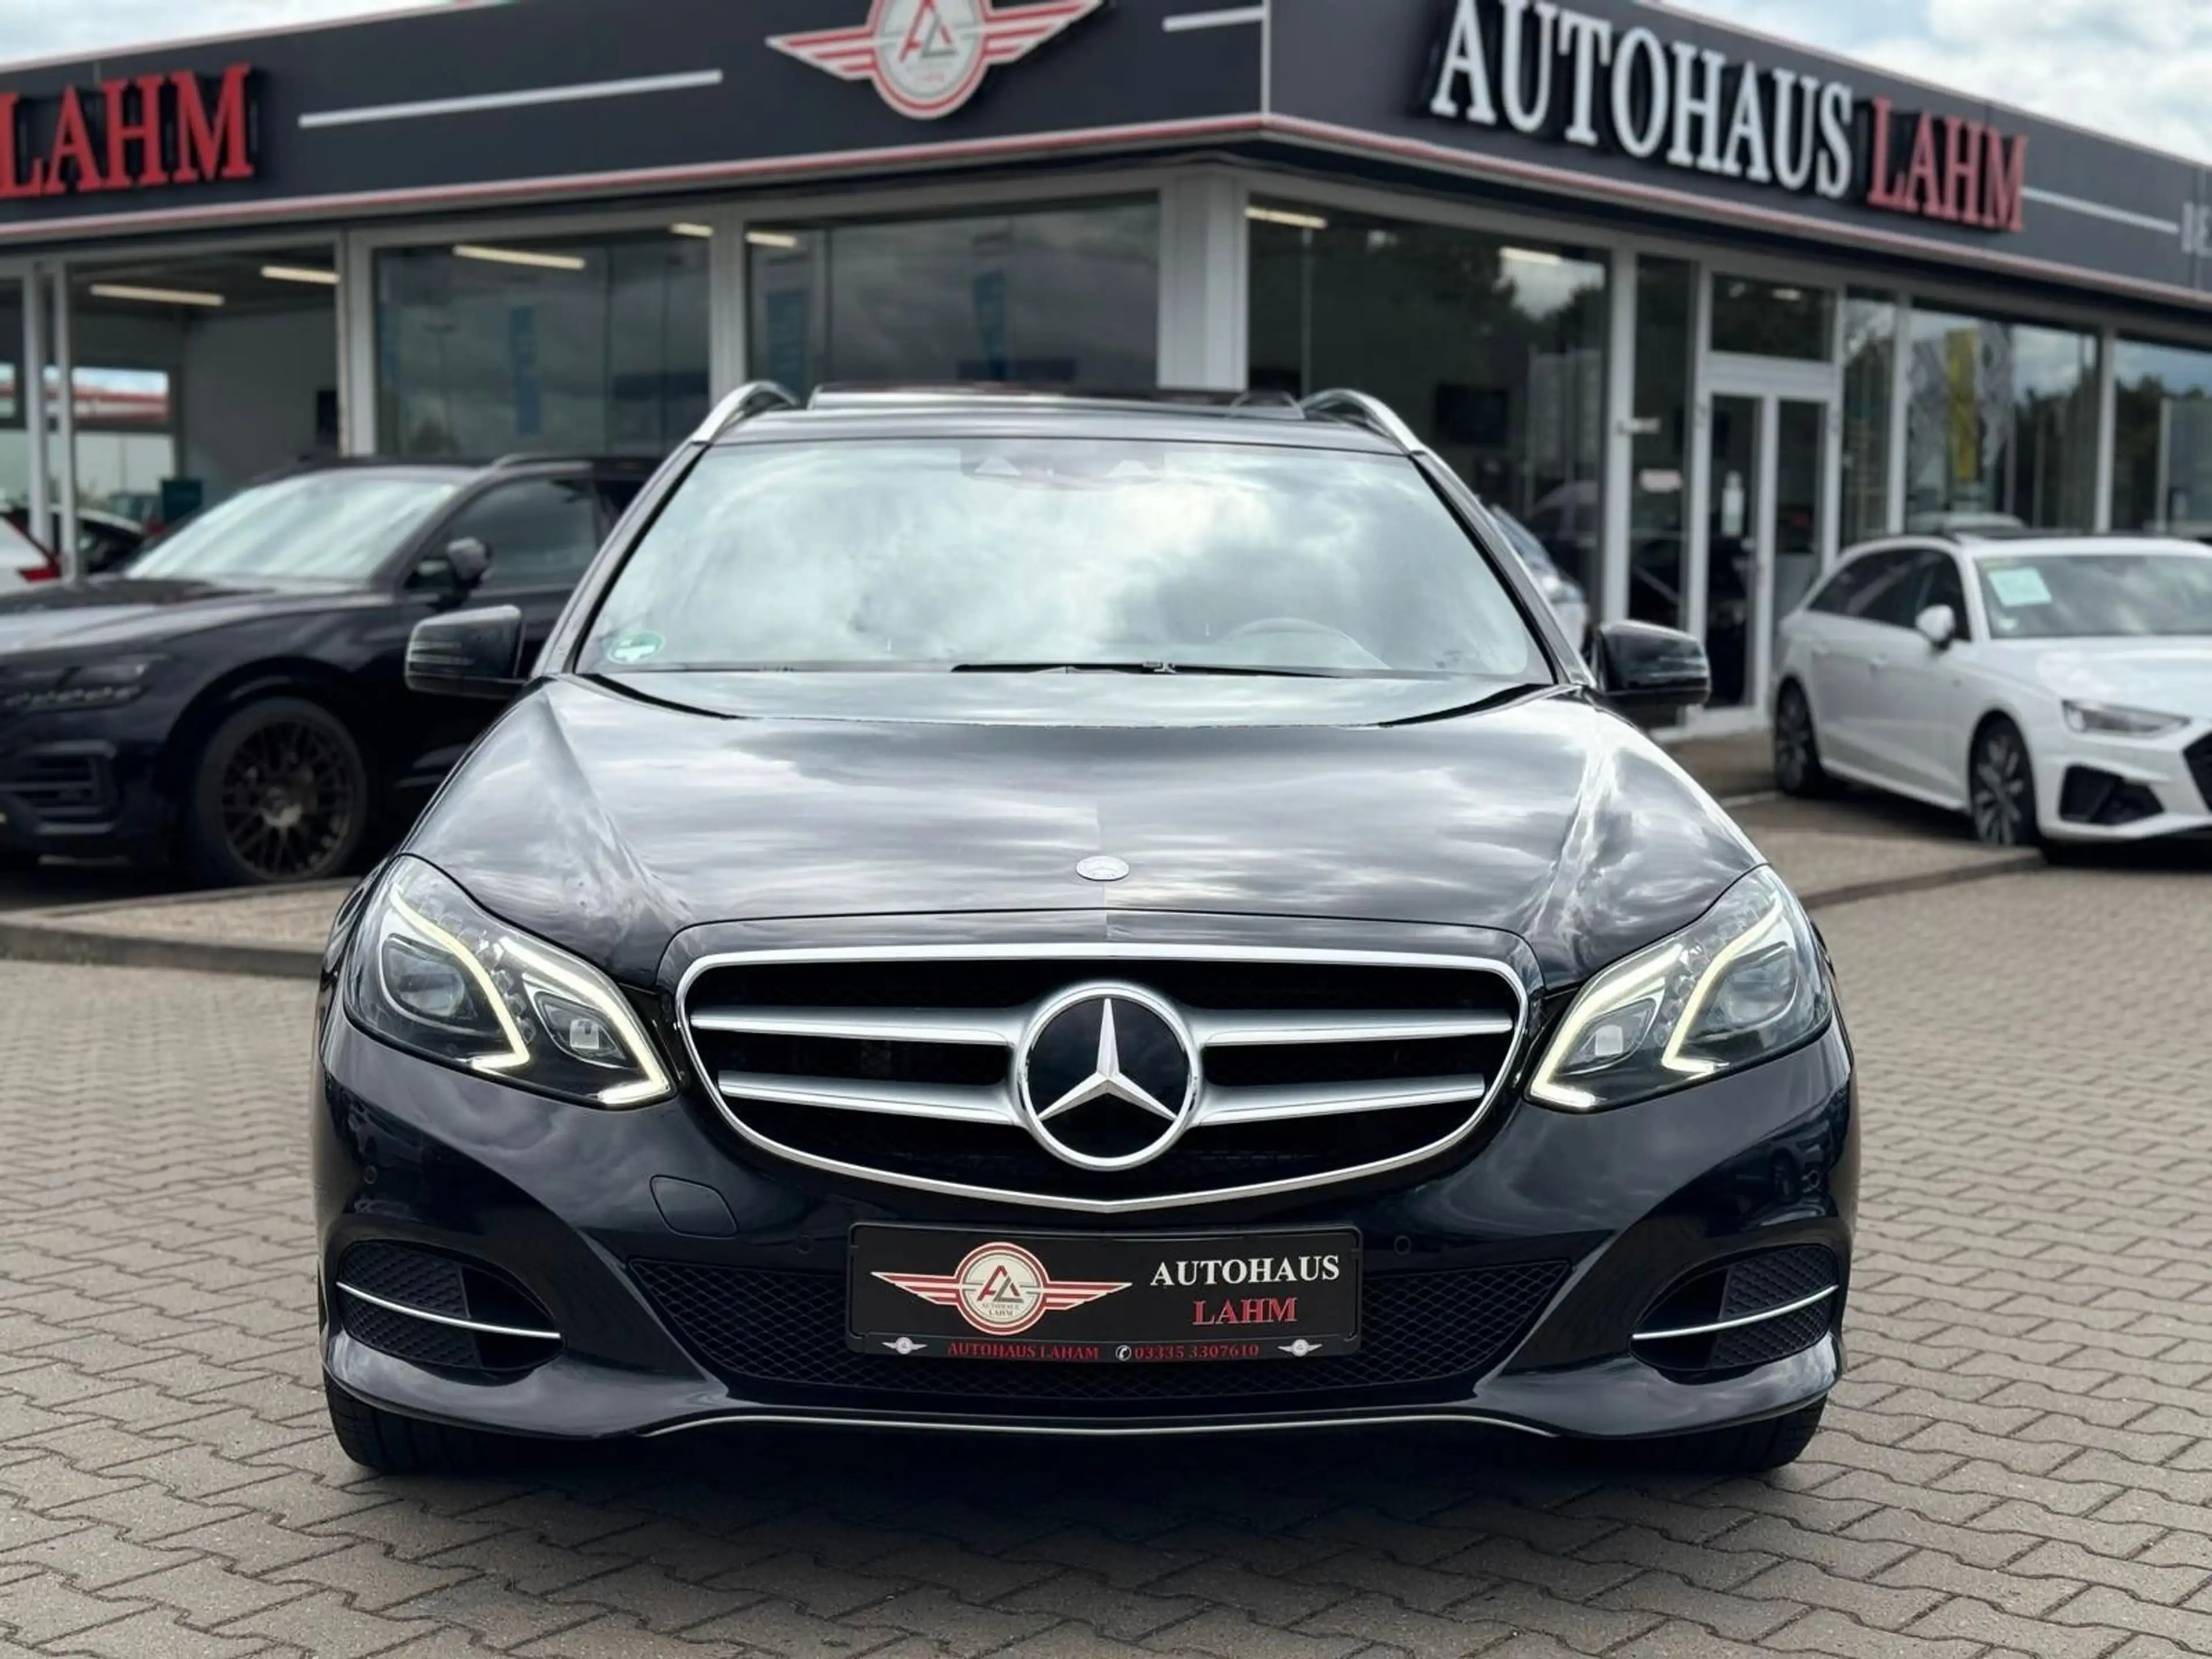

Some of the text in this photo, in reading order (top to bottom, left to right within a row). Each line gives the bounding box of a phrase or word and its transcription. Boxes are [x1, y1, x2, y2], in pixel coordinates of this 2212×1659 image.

[0, 62, 255, 199] LAHM
[1430, 0, 2029, 232] AUTOHAUS LAHM
[1150, 1255, 1340, 1286] AUTOHAUS
[1192, 1297, 1298, 1325] LAHM
[947, 1342, 1099, 1360] AUTOHAUS LAHAM
[1135, 1344, 1260, 1359] 03335 3307610
